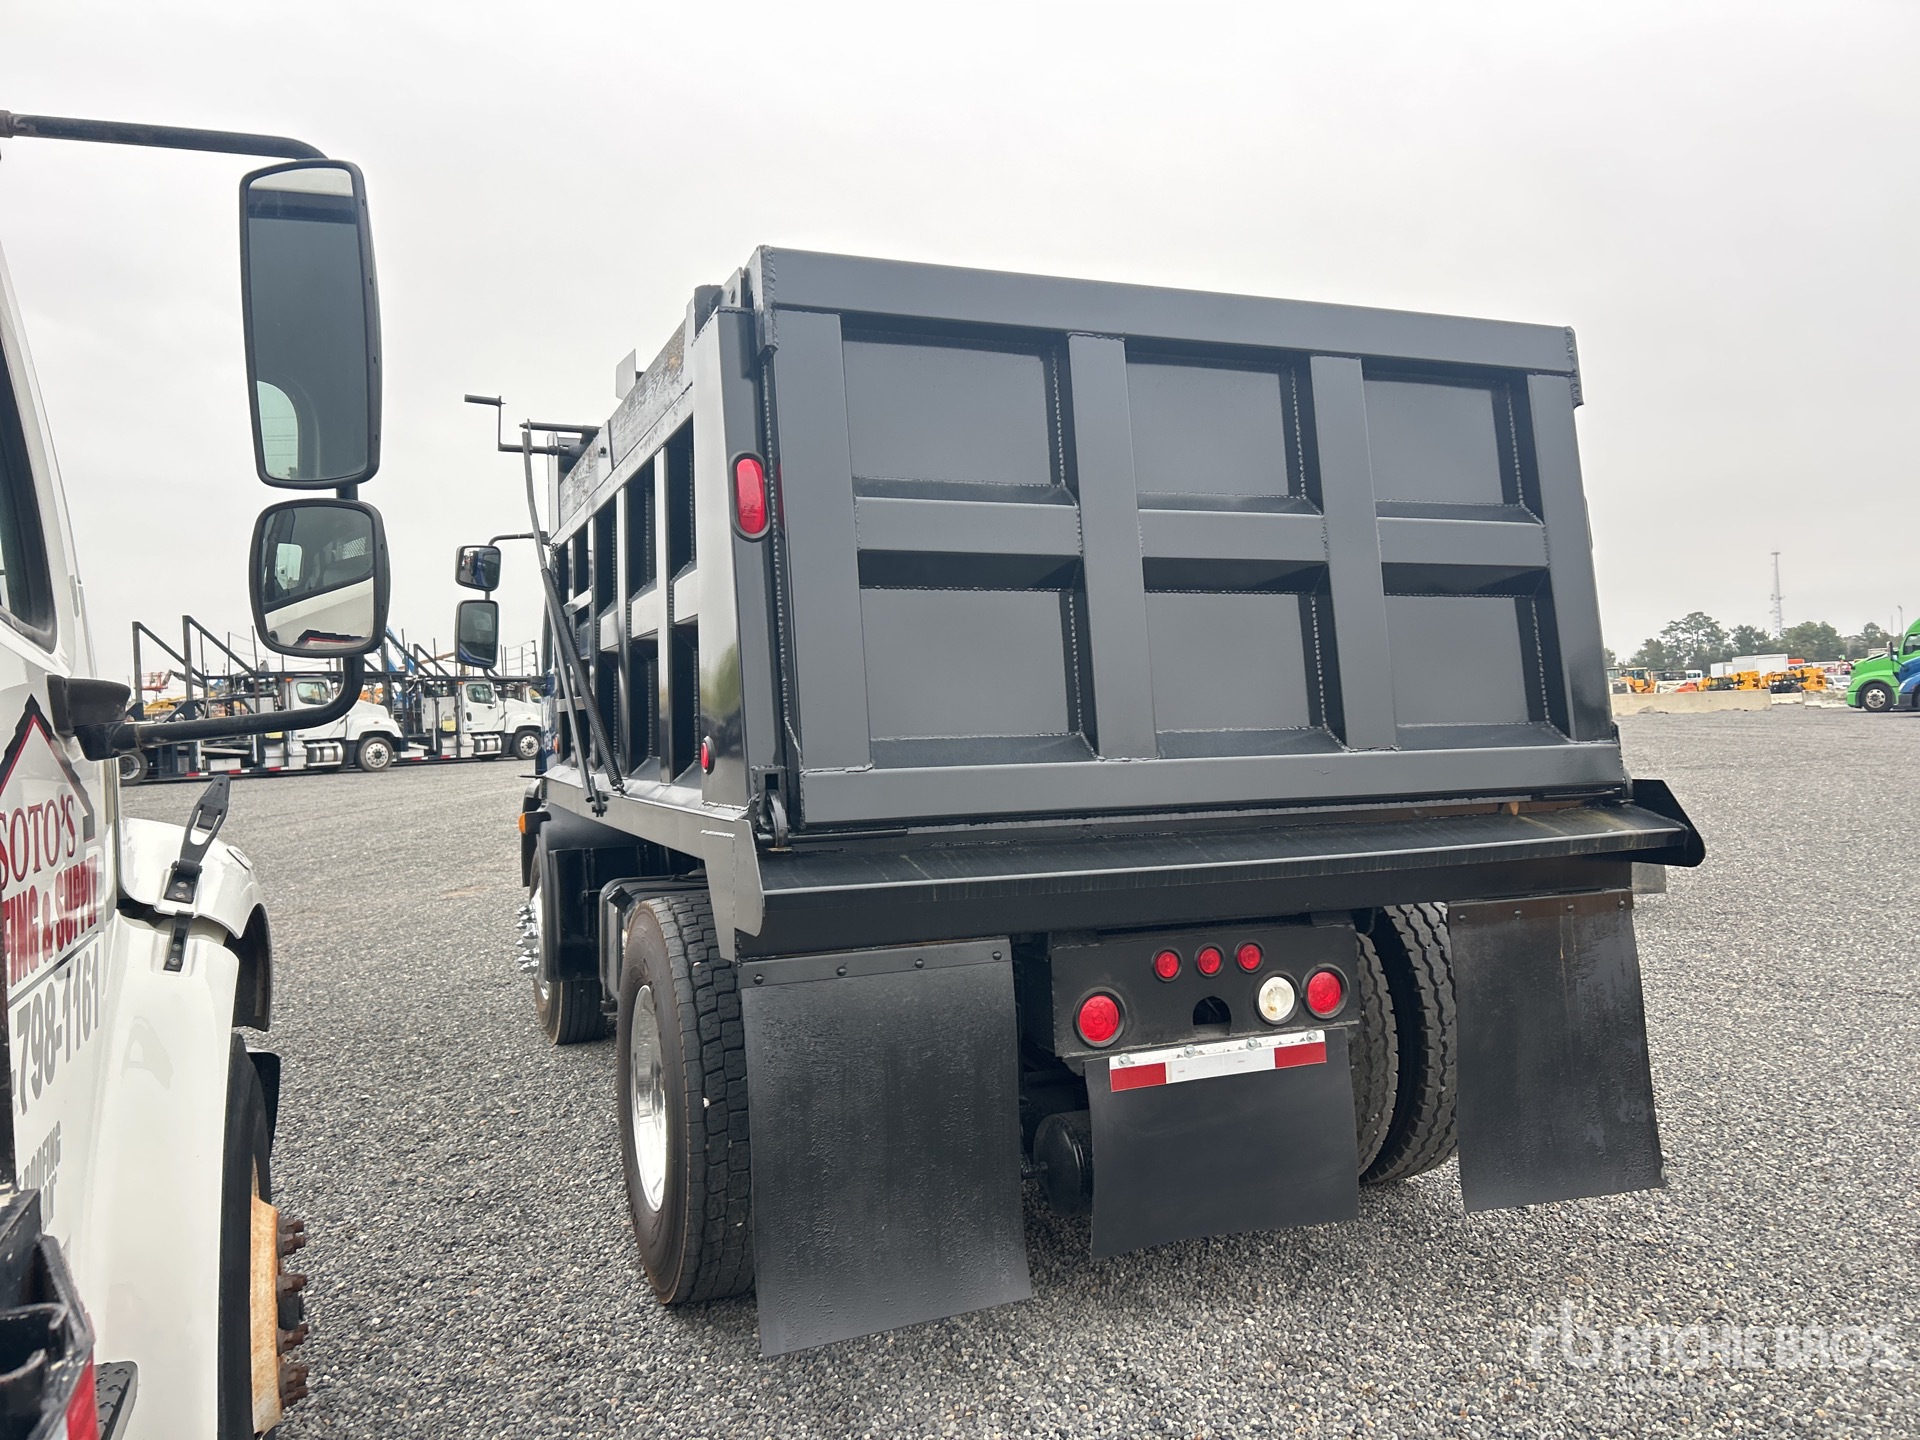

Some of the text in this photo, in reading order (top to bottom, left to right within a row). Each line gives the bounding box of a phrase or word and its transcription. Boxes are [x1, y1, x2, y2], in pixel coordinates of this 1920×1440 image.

[0, 793, 76, 891] SOTO'S
[42, 891, 53, 963] &
[55, 854, 97, 952] SUPPLY
